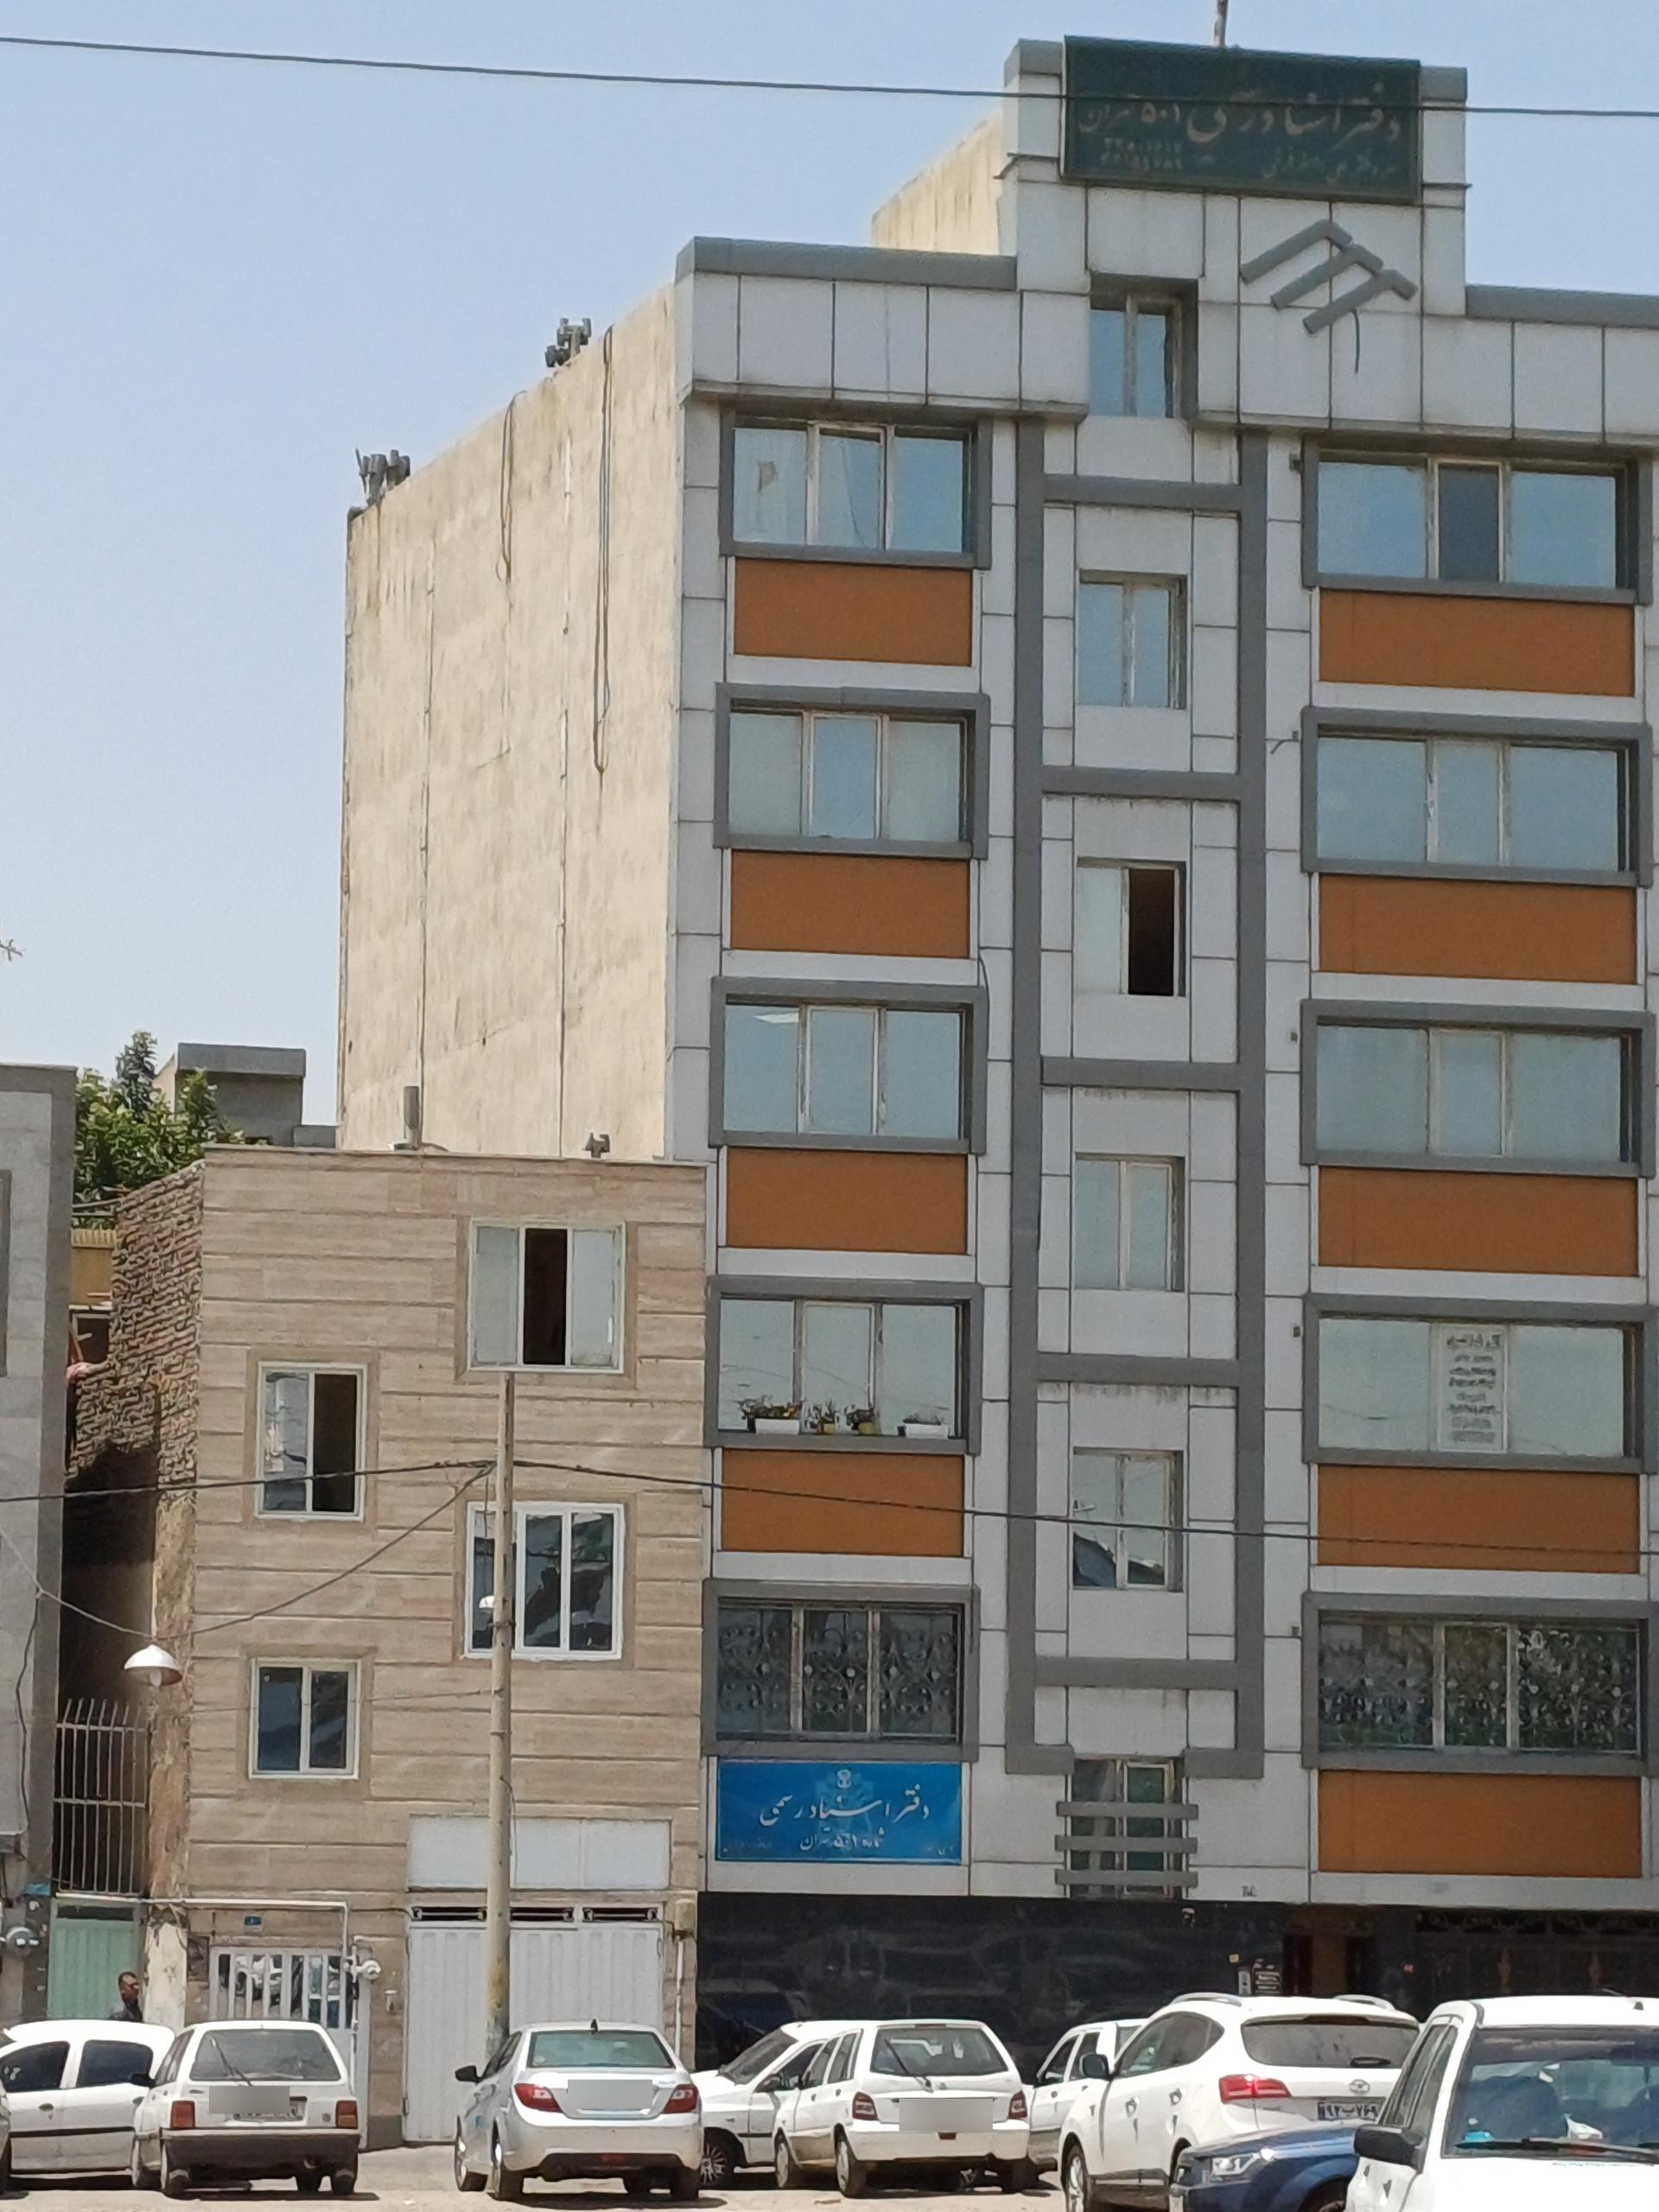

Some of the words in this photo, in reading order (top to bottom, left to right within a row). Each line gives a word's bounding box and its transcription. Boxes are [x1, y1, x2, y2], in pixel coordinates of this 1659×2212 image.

[759, 1793, 804, 1827] رسمی
[809, 1795, 891, 1820] اسناد
[893, 1783, 930, 1824] دفتر
[799, 1826, 831, 1852] تهران
